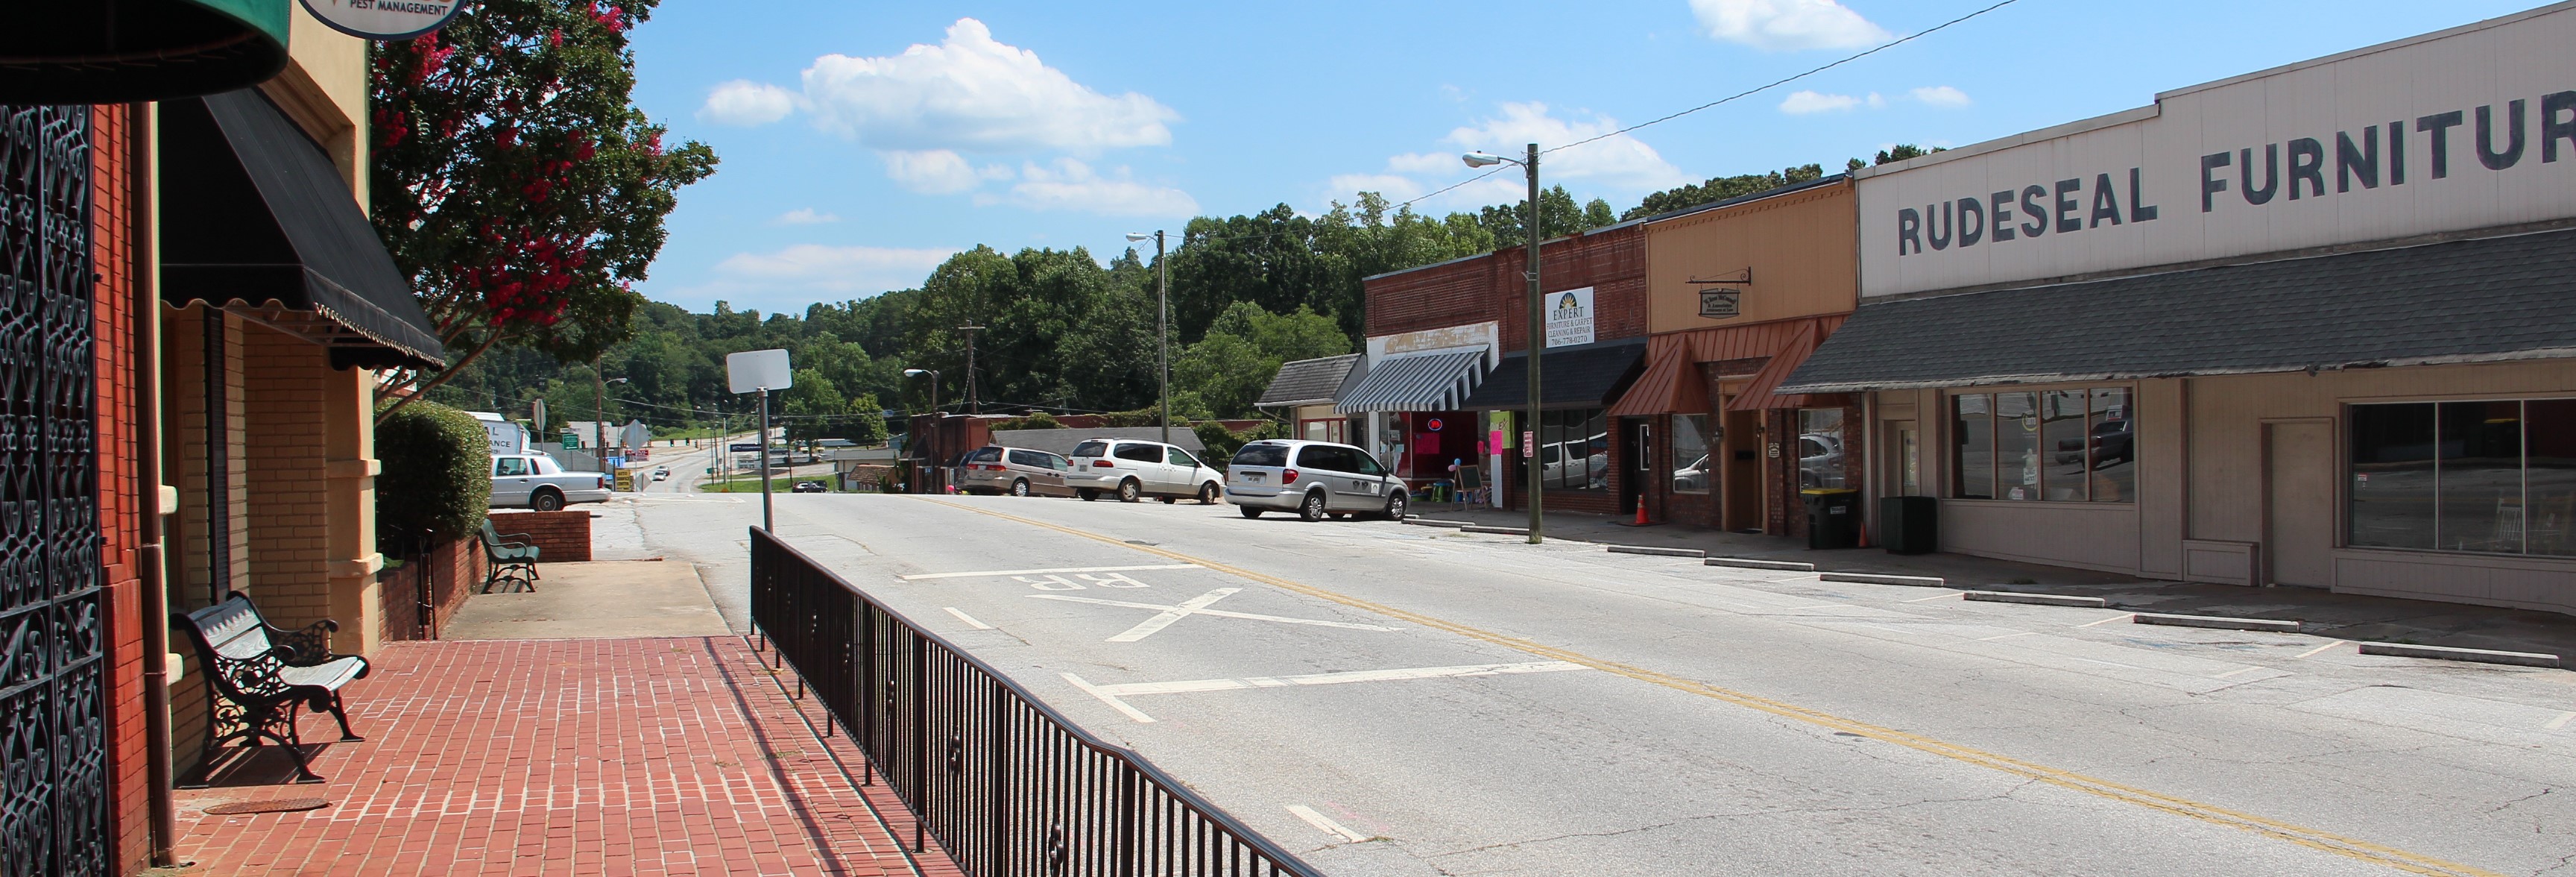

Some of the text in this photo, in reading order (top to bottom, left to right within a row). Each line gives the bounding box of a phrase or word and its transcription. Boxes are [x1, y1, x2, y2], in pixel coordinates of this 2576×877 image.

[350, 0, 449, 16] PEST MANAGEMENT
[1898, 166, 2158, 257] RUDESEAL
[1553, 307, 1585, 321] EXPERT
[1547, 320, 1570, 330] FURNITURE
[1574, 317, 1593, 327] CARPET
[1547, 329, 1570, 338] CLEANING
[1573, 327, 1591, 335] REPAIR
[1551, 335, 1588, 345] 706-778-0270
